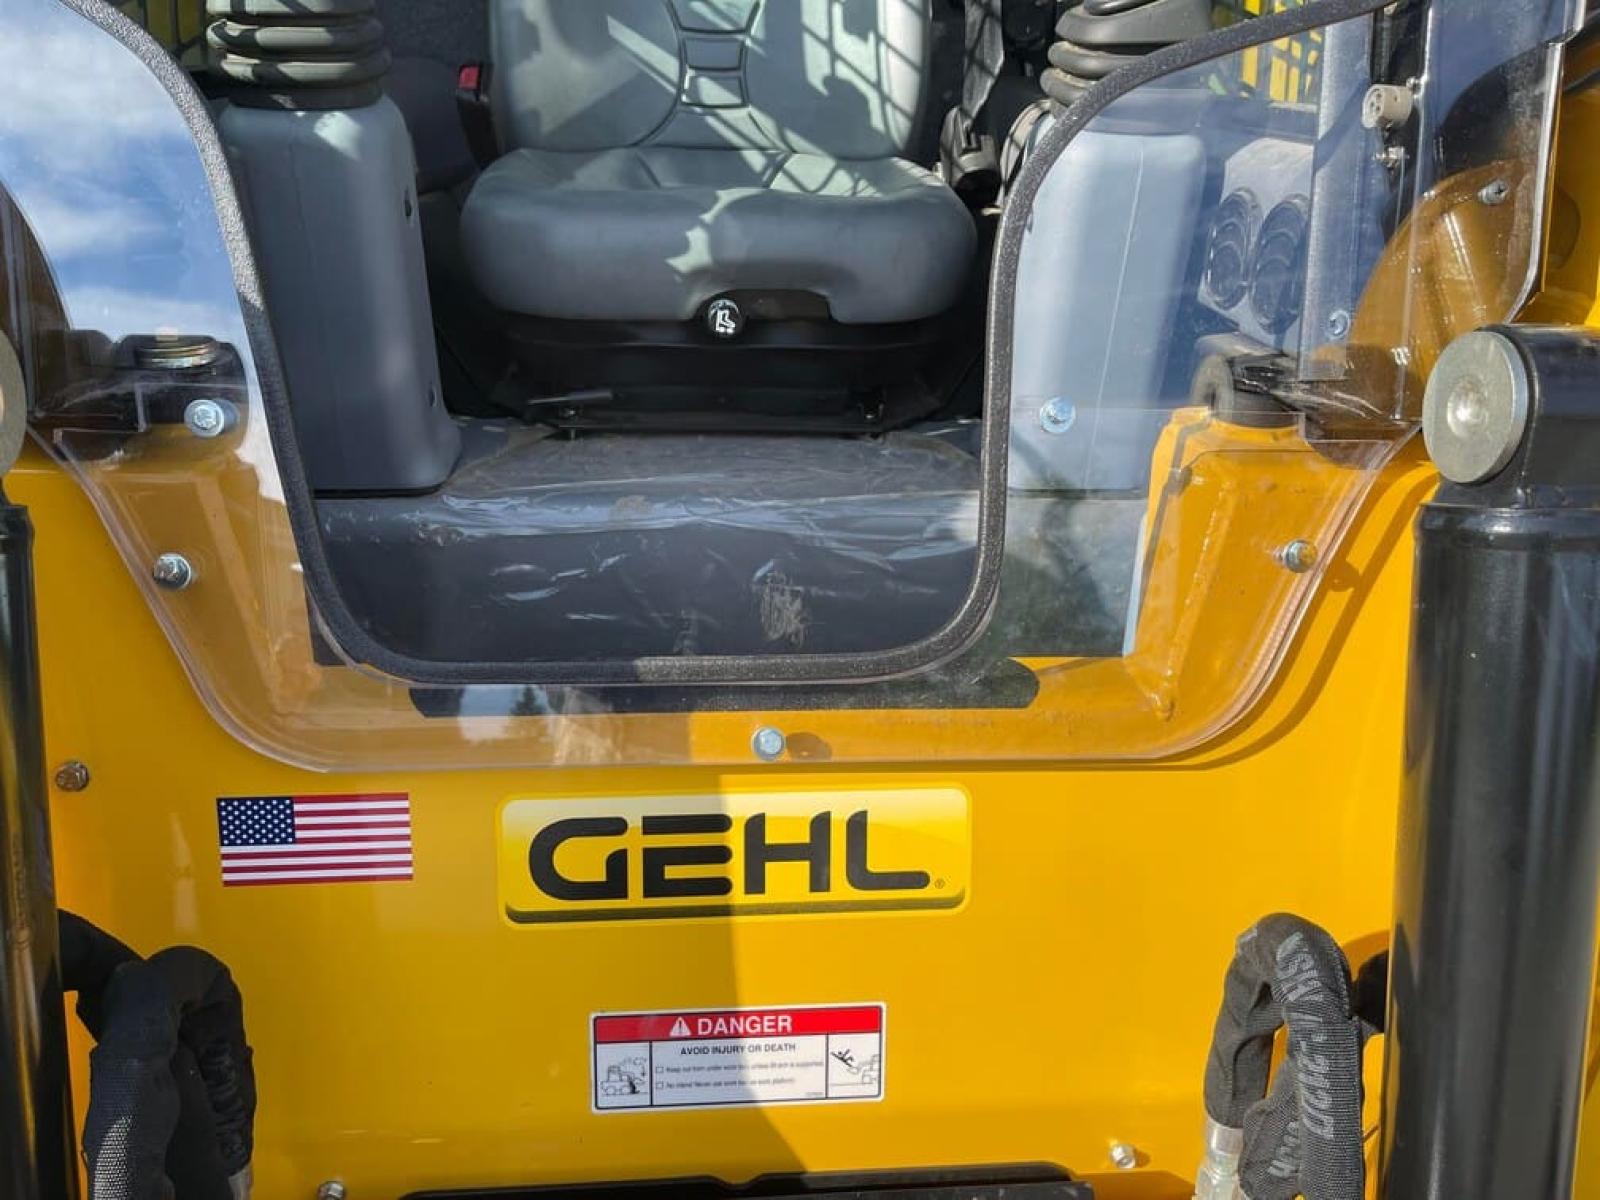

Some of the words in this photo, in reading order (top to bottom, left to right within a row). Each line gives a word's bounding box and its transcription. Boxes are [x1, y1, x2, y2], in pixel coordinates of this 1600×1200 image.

[529, 810, 931, 900] GEHL
[697, 1015, 793, 1036] DANGER
[680, 1048, 710, 1056] AVOID
[711, 1045, 745, 1055] INJURY
[747, 1044, 762, 1053] OR
[764, 1043, 796, 1053] DEATH
